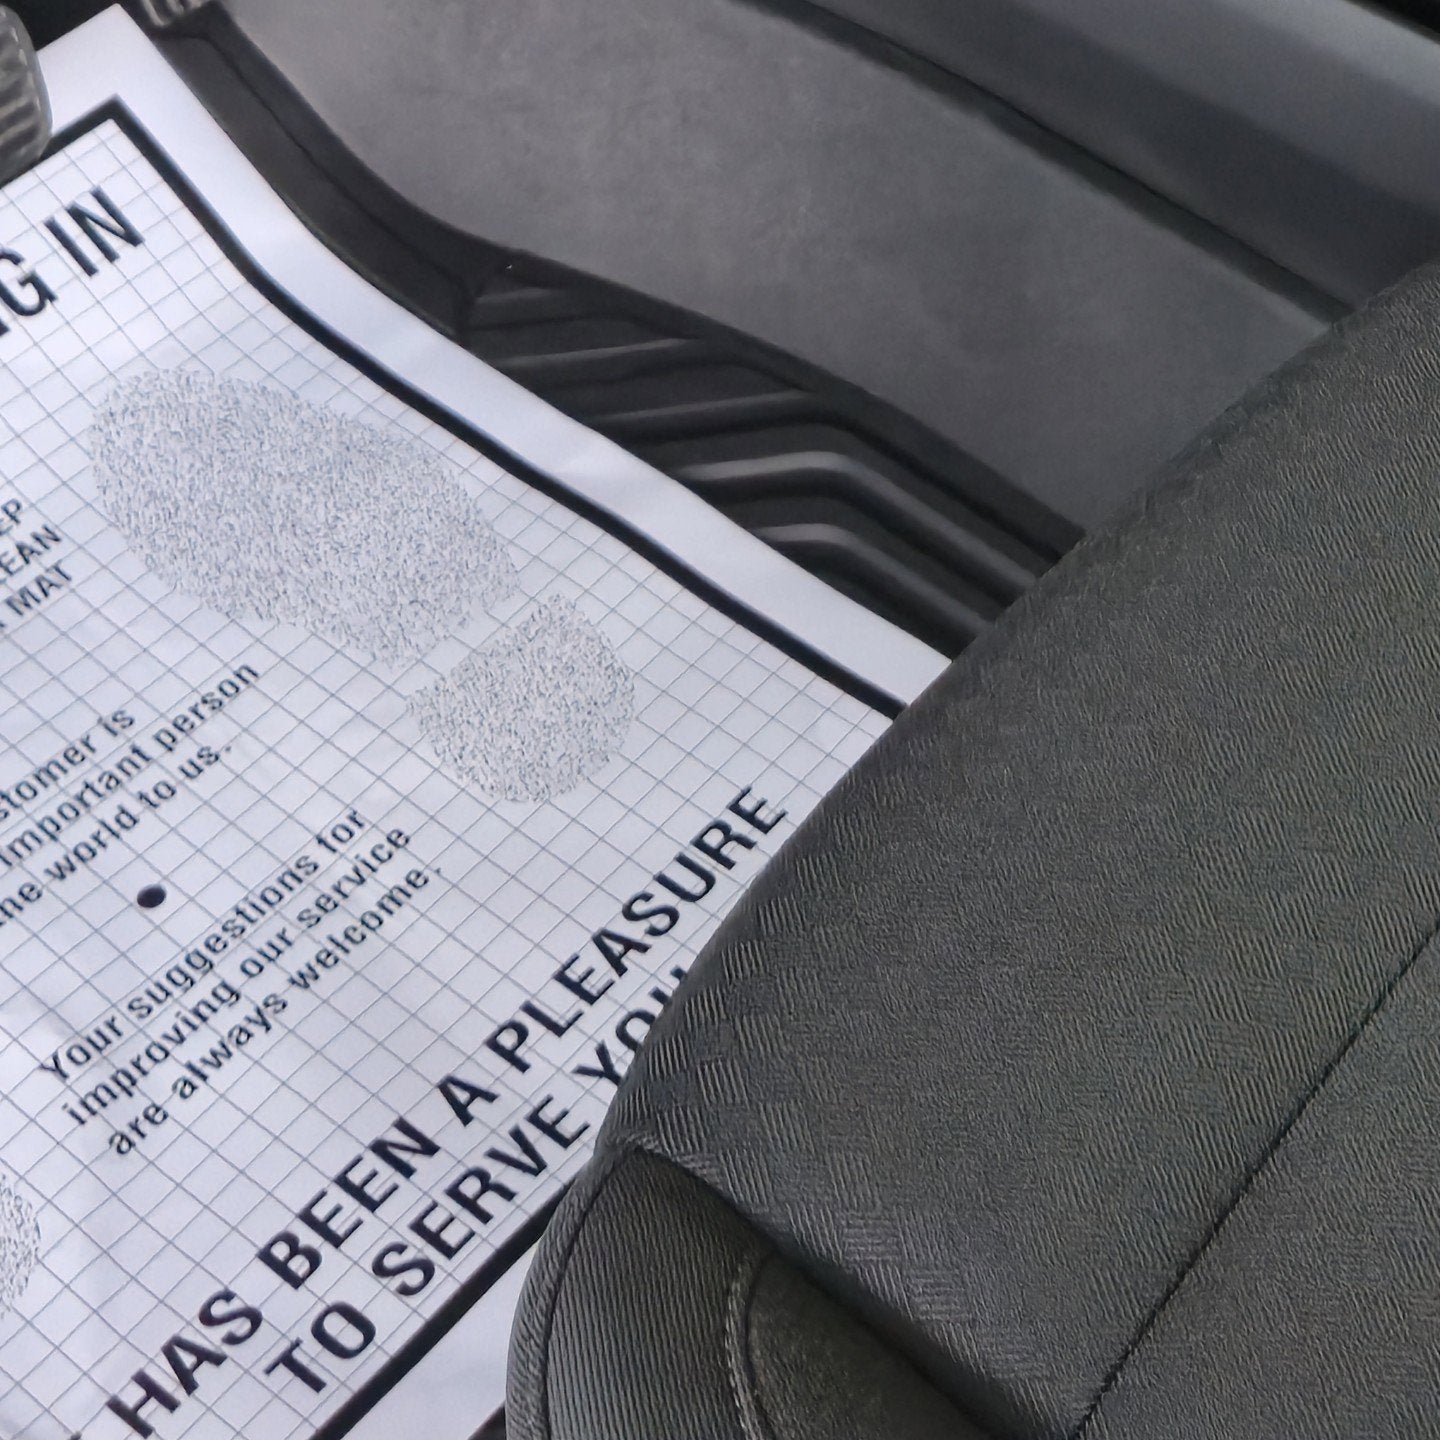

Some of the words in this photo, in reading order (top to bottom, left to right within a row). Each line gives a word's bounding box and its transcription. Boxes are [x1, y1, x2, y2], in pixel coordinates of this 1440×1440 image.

[43, 185, 146, 278] IN
[7, 562, 75, 620] MAT
[101, 707, 137, 740] is
[156, 662, 264, 755] person
[44, 803, 142, 882] world
[138, 777, 178, 812] to
[177, 744, 235, 782] us.
[37, 1014, 128, 1085] Your
[126, 851, 322, 1021] suggestions
[314, 806, 370, 852] for
[60, 978, 245, 1127] improving
[238, 926, 296, 981] our
[295, 825, 414, 931] service
[107, 1100, 172, 1156] are
[171, 989, 291, 1102] always
[287, 865, 445, 993] welcome.
[105, 1288, 265, 1440] HAS
[258, 1117, 443, 1291] BEEN
[435, 1072, 500, 1127] A
[485, 784, 790, 1073] PLEASURE
[265, 1299, 378, 1396] TO
[370, 1095, 592, 1297] SERVE
[572, 964, 687, 1087] YO
